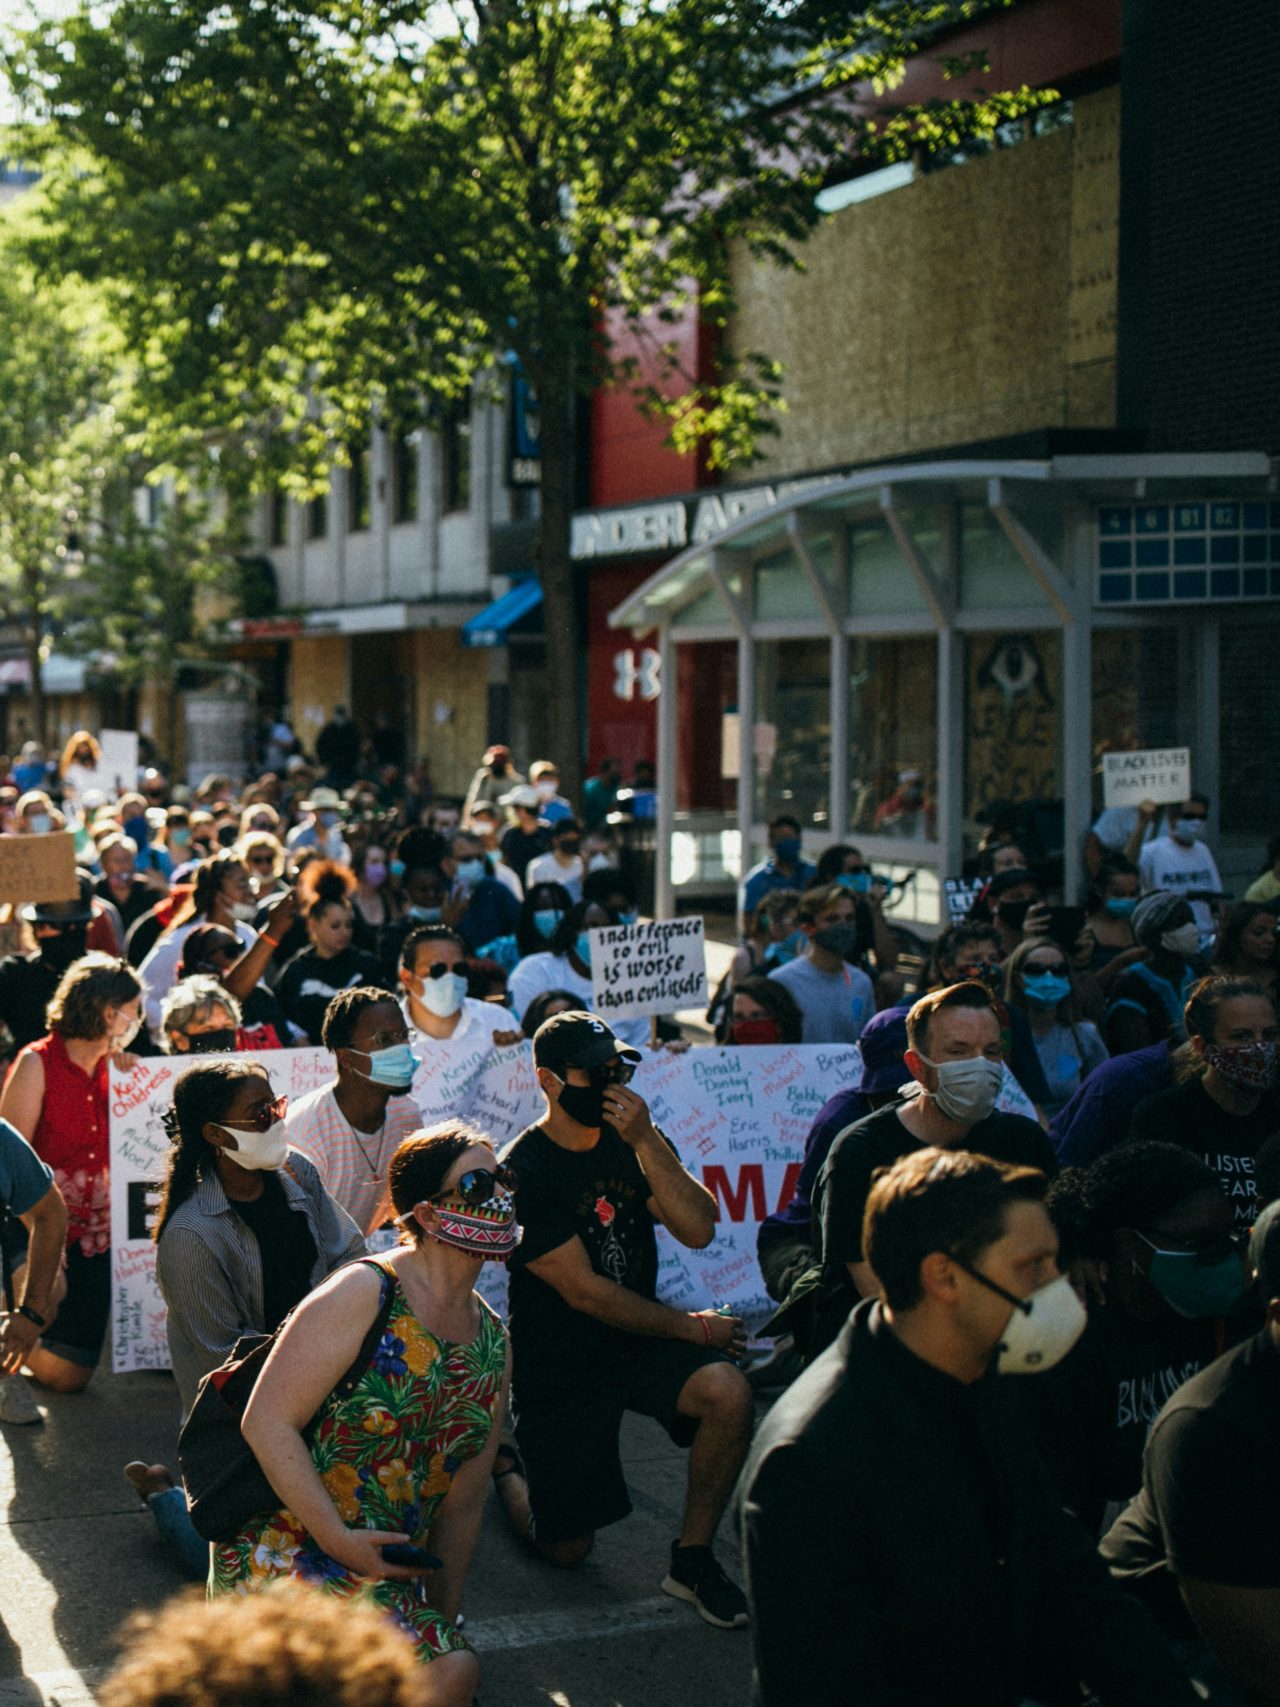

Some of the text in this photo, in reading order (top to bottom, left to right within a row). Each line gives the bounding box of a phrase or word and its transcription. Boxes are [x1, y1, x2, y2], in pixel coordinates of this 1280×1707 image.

[570, 501, 688, 560] NDER
[1108, 752, 1188, 773] BLACK LIVES
[1113, 773, 1181, 789] MATTER
[613, 938, 669, 958] to evil
[604, 955, 685, 985] is worse
[597, 987, 634, 1008] than
[291, 1055, 334, 1075] Richar
[442, 1051, 482, 1082] Kevin
[693, 1055, 741, 1080] Donald
[816, 1050, 861, 1071] Brand
[113, 1062, 151, 1098] Keith
[112, 1066, 172, 1118] Childress
[475, 1083, 521, 1115] Richard
[715, 1092, 753, 1108] Ivory
[786, 1086, 827, 1105] Bobby
[421, 1102, 458, 1116] maine
[730, 1117, 760, 1134] Eric
[728, 1136, 771, 1153] Harris
[118, 1141, 154, 1171] Noel
[700, 1252, 753, 1288] Bernard
[115, 1287, 130, 1356] Christopher
